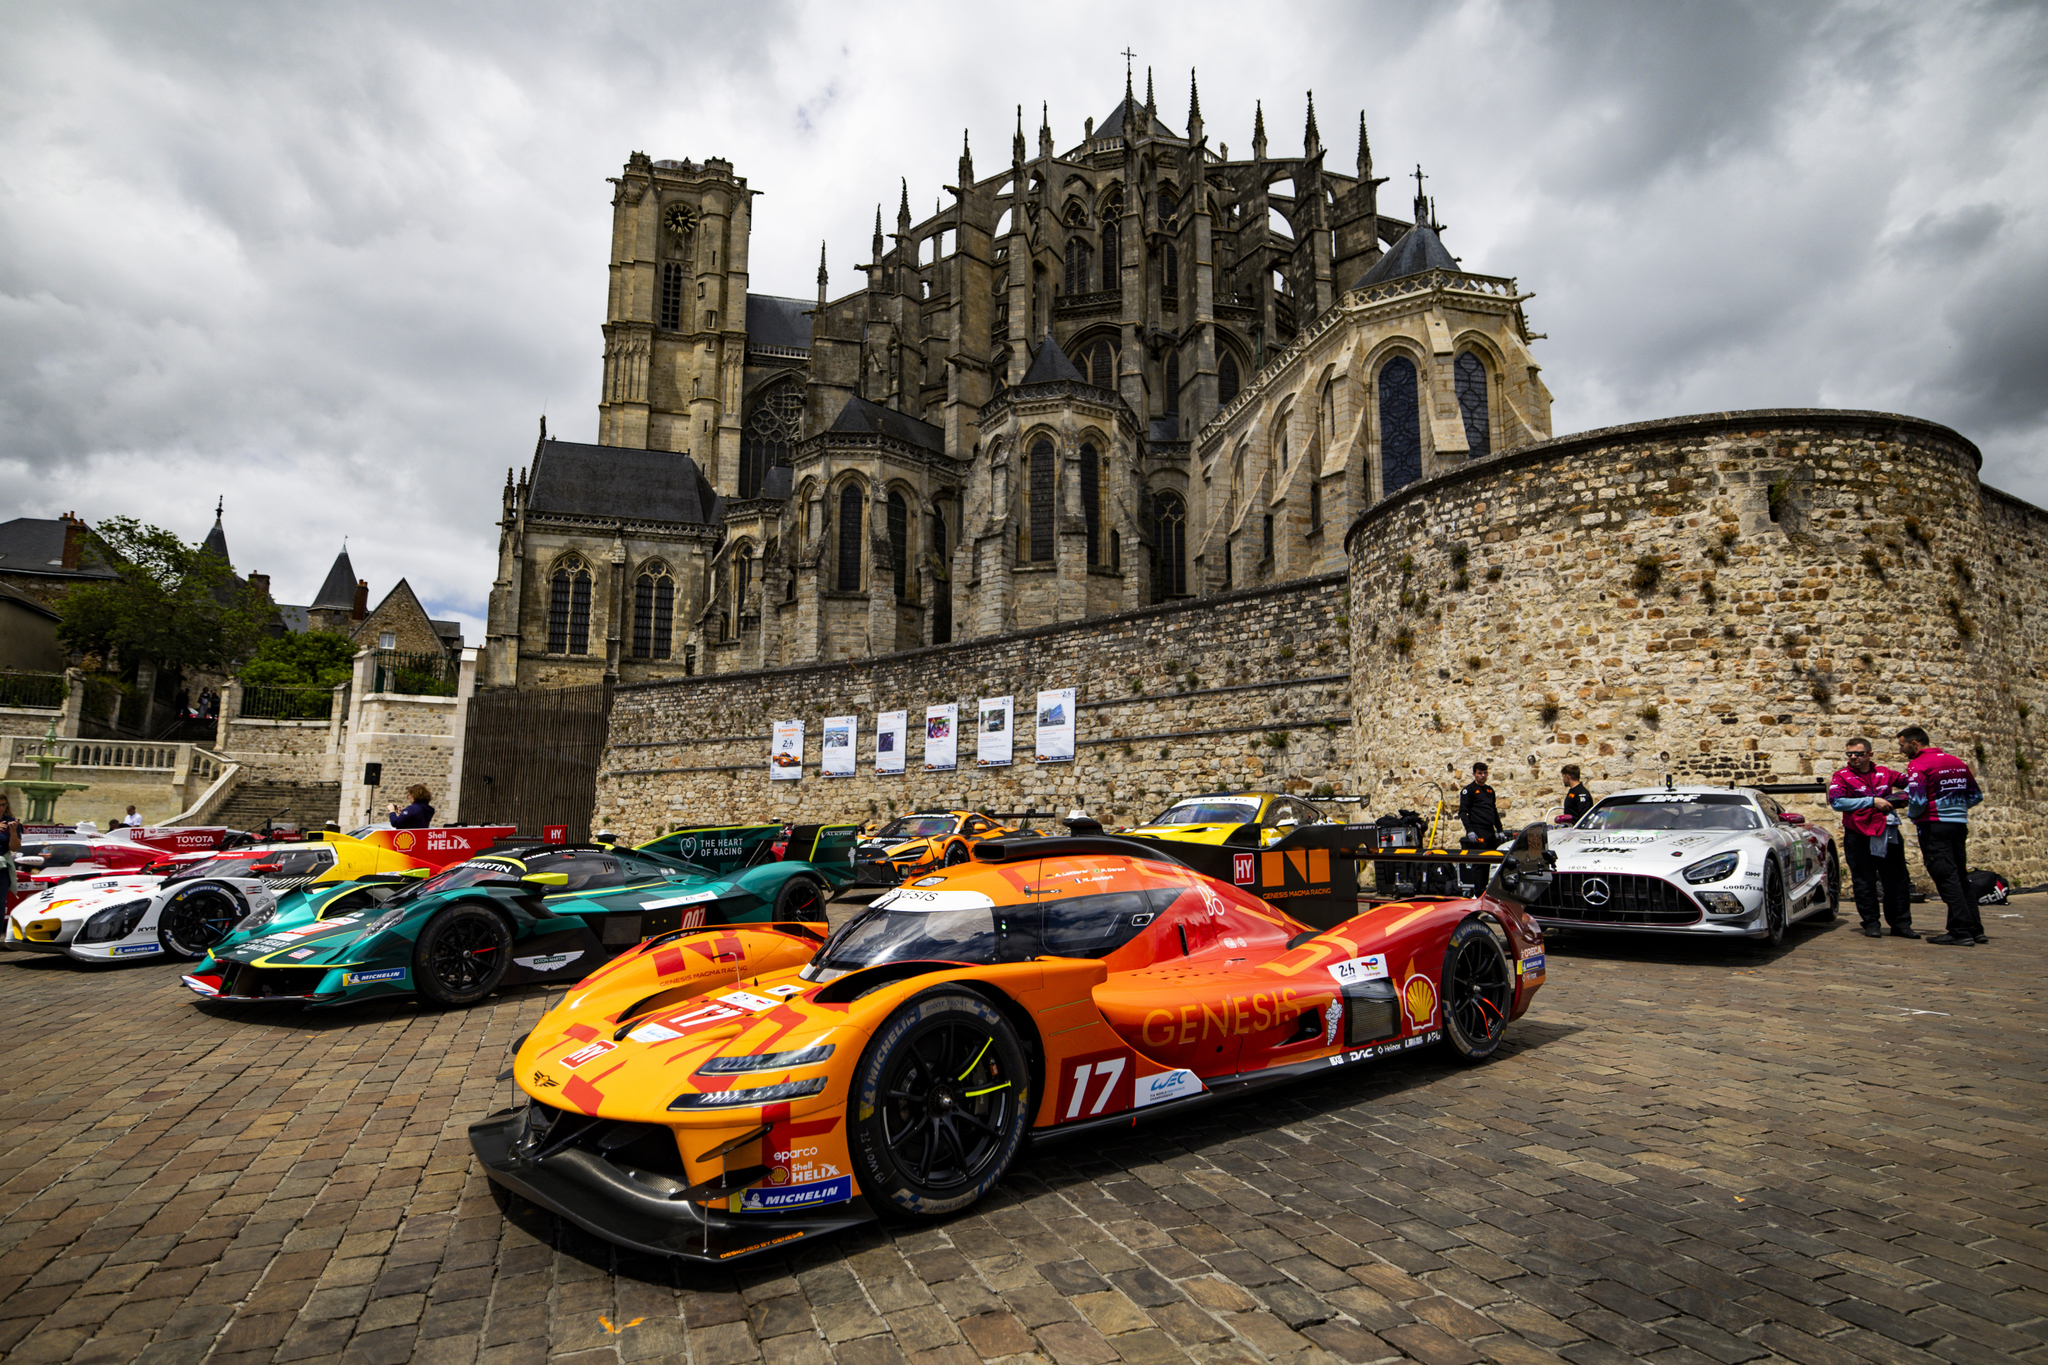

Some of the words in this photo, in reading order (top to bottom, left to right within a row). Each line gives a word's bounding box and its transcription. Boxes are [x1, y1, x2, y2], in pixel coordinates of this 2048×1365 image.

[131, 830, 144, 839] HY
[551, 830, 561, 839] HY
[428, 836, 471, 850] HELIX
[701, 839, 716, 848] THE
[718, 838, 743, 847] HEART
[714, 847, 742, 856] RACING
[470, 862, 513, 873] MARTIN
[1236, 859, 1252, 878] HY
[188, 886, 219, 894] MICHELIN
[681, 908, 706, 936] 007
[1460, 924, 1488, 936] MICHELIN
[1525, 946, 1542, 957] ORECA
[1527, 960, 1542, 968] MICHELIN
[361, 971, 400, 980] MICHELIN
[660, 975, 692, 987] GENESIS
[693, 970, 720, 979] MAGMA
[926, 1001, 945, 1011] PILOT
[1142, 988, 1302, 1047] GENESIS
[568, 1043, 608, 1063] HY
[868, 1011, 917, 1086] MICHELIN
[1066, 1057, 1126, 1118] 17
[1150, 1071, 1187, 1091] WEC
[1150, 1093, 1173, 1101] CHAMPIONSHIP
[774, 1147, 818, 1162] sparco
[982, 1118, 1023, 1192] MICHELIN
[792, 1161, 813, 1172] Shell
[792, 1164, 840, 1183] HELIX
[765, 1186, 838, 1205] MICHELIN
[720, 1244, 760, 1259] DESIGNED
[772, 1231, 804, 1244] GENESIS
